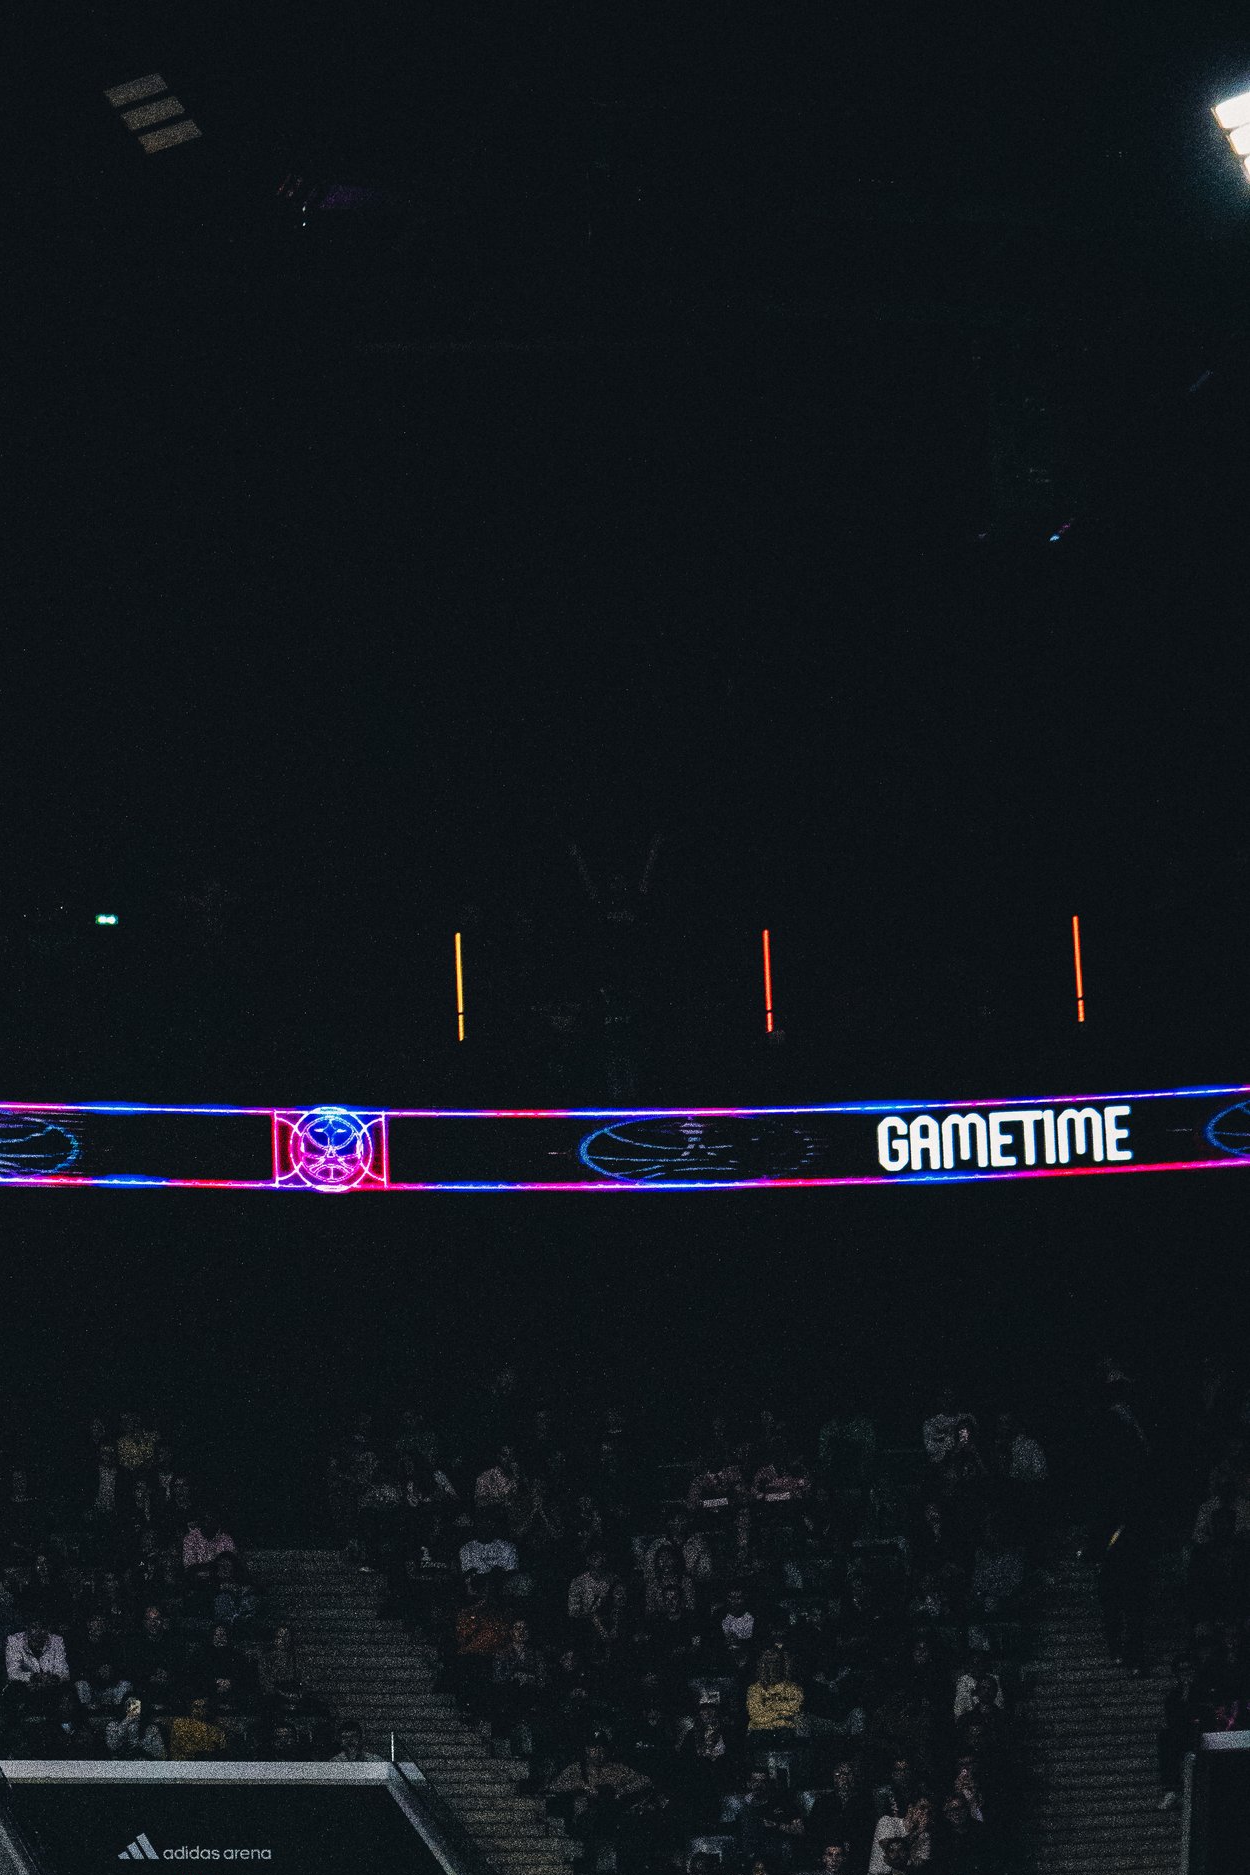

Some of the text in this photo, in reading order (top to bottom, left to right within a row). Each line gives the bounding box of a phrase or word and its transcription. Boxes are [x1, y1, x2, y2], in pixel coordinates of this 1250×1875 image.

[877, 1106, 1131, 1171] GAMETIME
[163, 1846, 272, 1860] adidas arena
